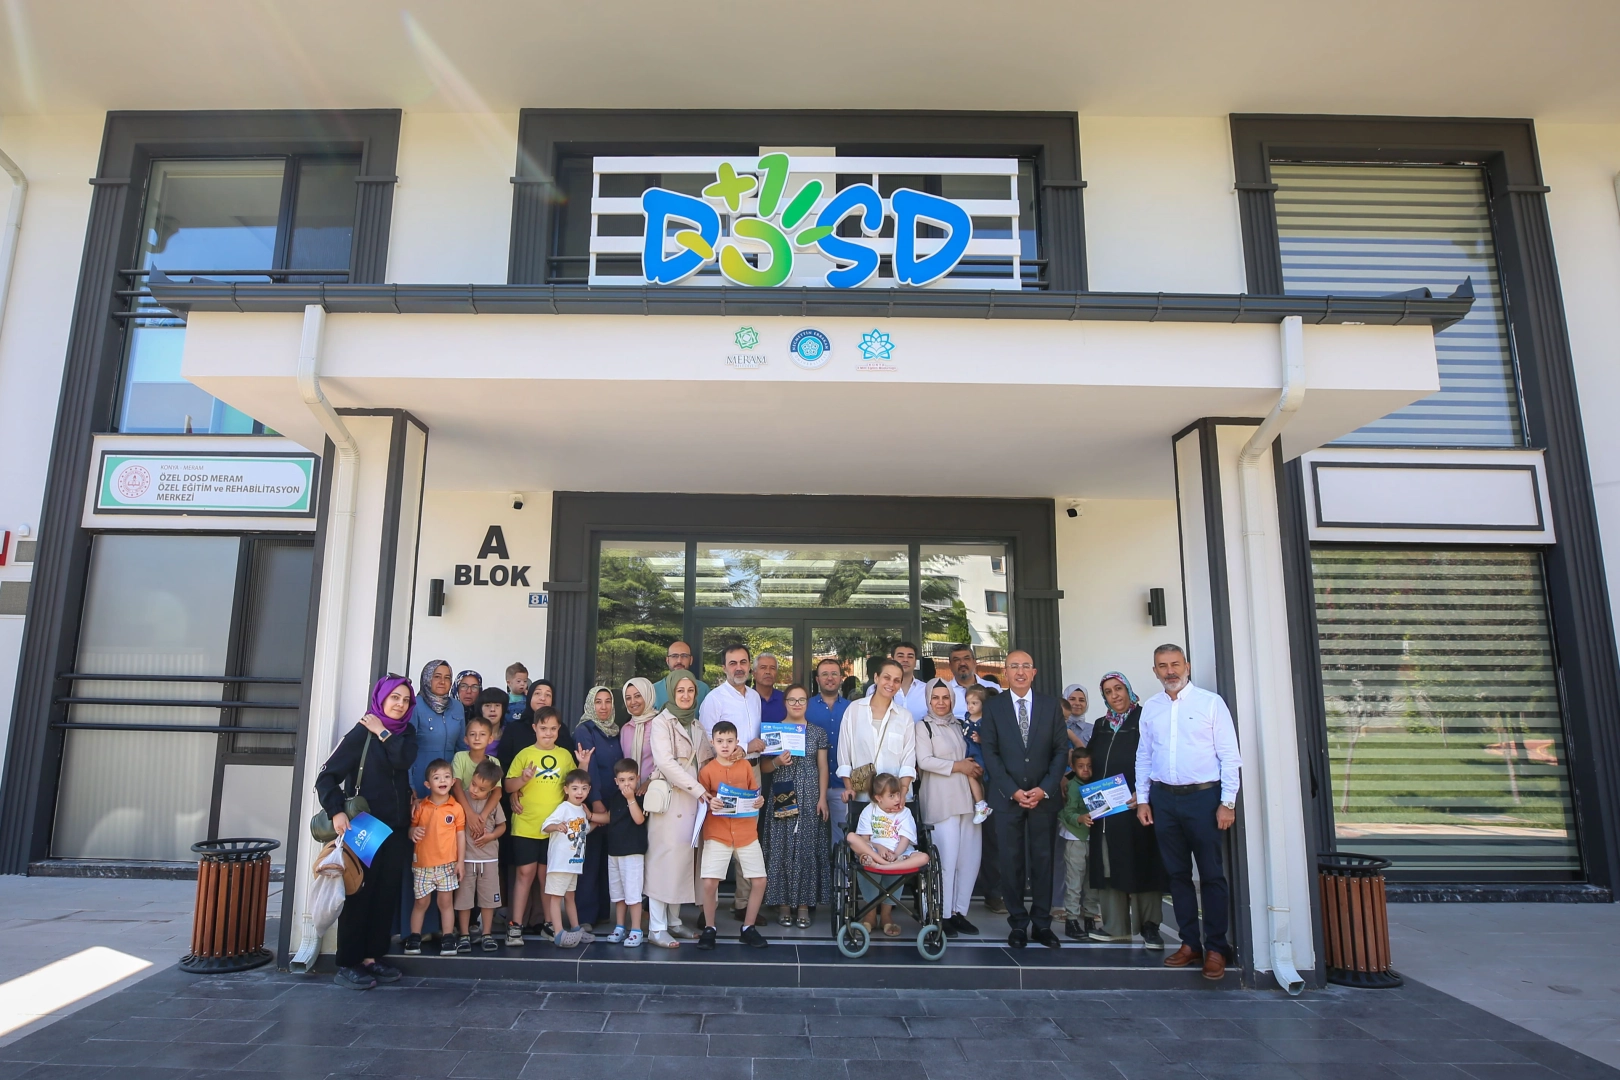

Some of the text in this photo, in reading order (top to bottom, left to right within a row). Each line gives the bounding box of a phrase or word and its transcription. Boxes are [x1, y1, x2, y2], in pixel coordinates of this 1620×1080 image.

[642, 184, 973, 288] DOSD
[726, 355, 767, 364] MERAM
[159, 472, 181, 481] ÖZEL
[183, 474, 208, 482] DOSD
[158, 482, 179, 492] ÖZEL
[182, 482, 212, 492] EĞİTİM
[225, 484, 300, 494] REHABİLİTASYON
[156, 492, 195, 501] MERKEZİ
[477, 525, 510, 559] A
[454, 564, 531, 587] BLOK
